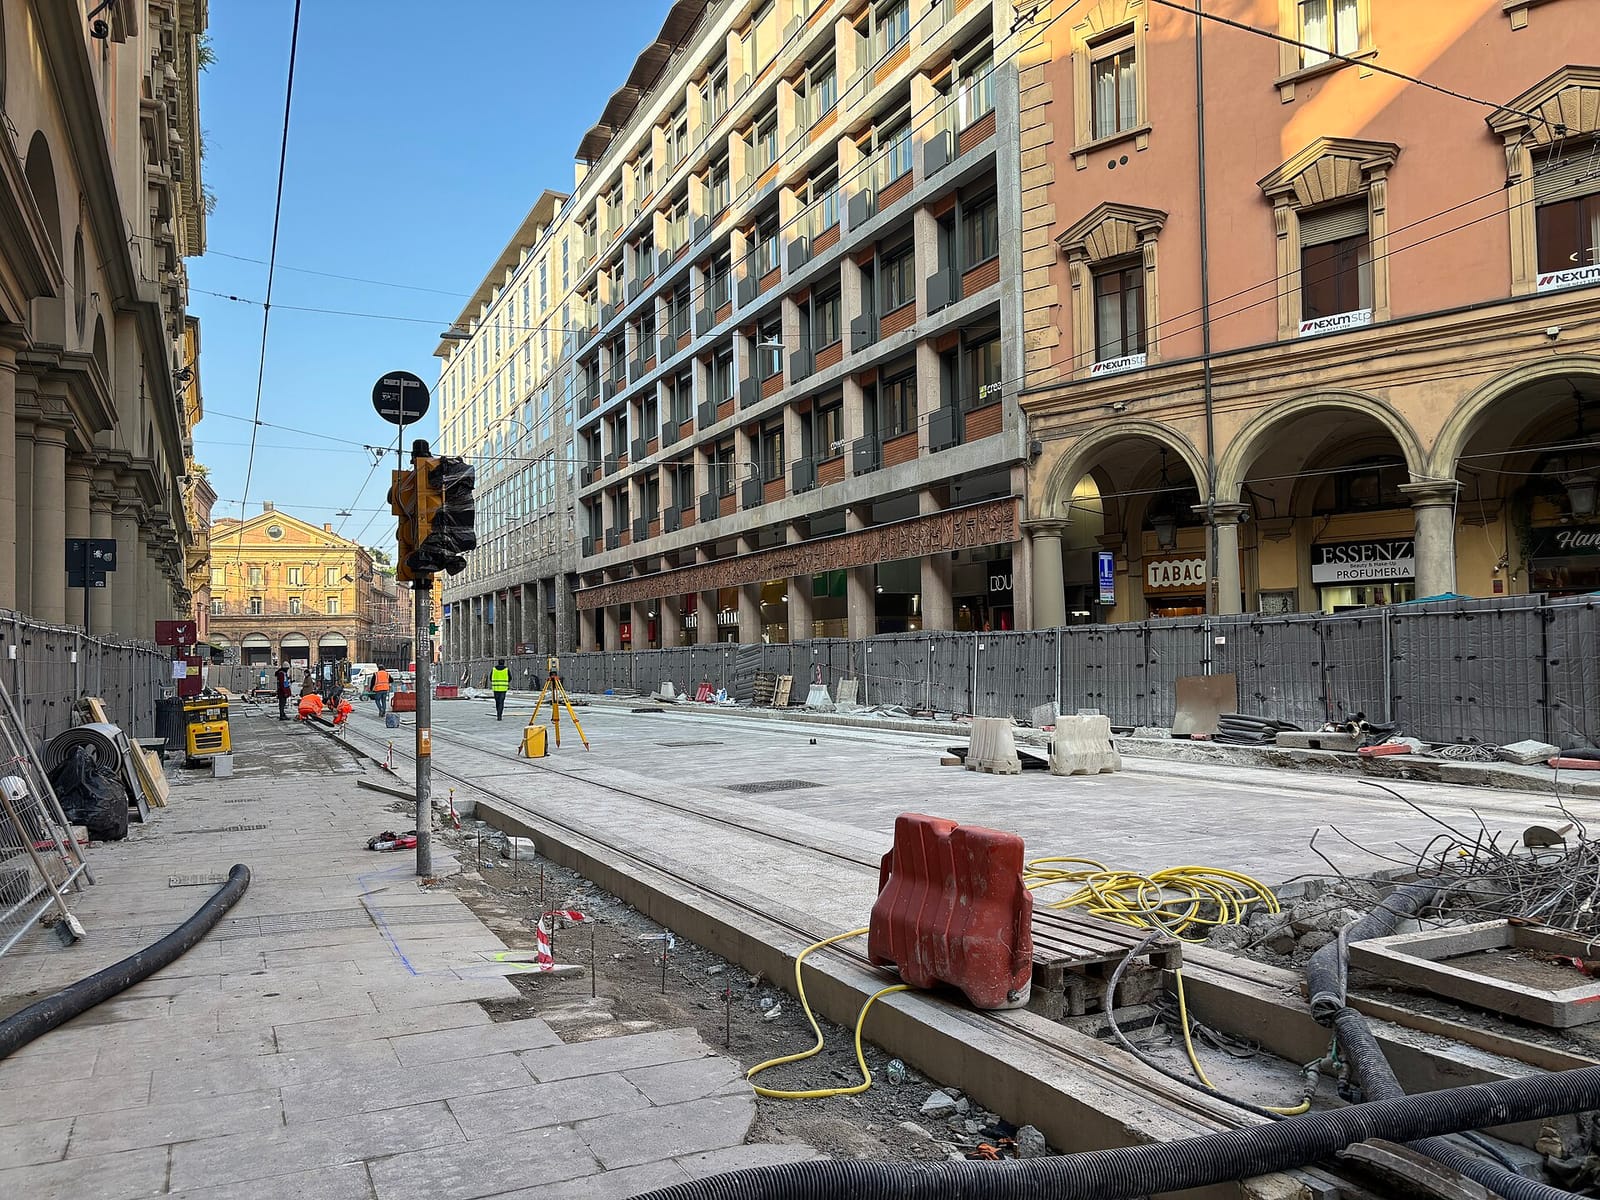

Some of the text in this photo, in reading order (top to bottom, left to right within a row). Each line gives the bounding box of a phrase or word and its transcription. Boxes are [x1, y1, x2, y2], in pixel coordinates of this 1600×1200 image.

[1314, 316, 1350, 329] NEXUM
[1321, 541, 1415, 565] ESSENZ
[990, 573, 1012, 591] DOU
[1151, 564, 1203, 582] TABAC
[1336, 567, 1410, 579] PROFUMERIA
